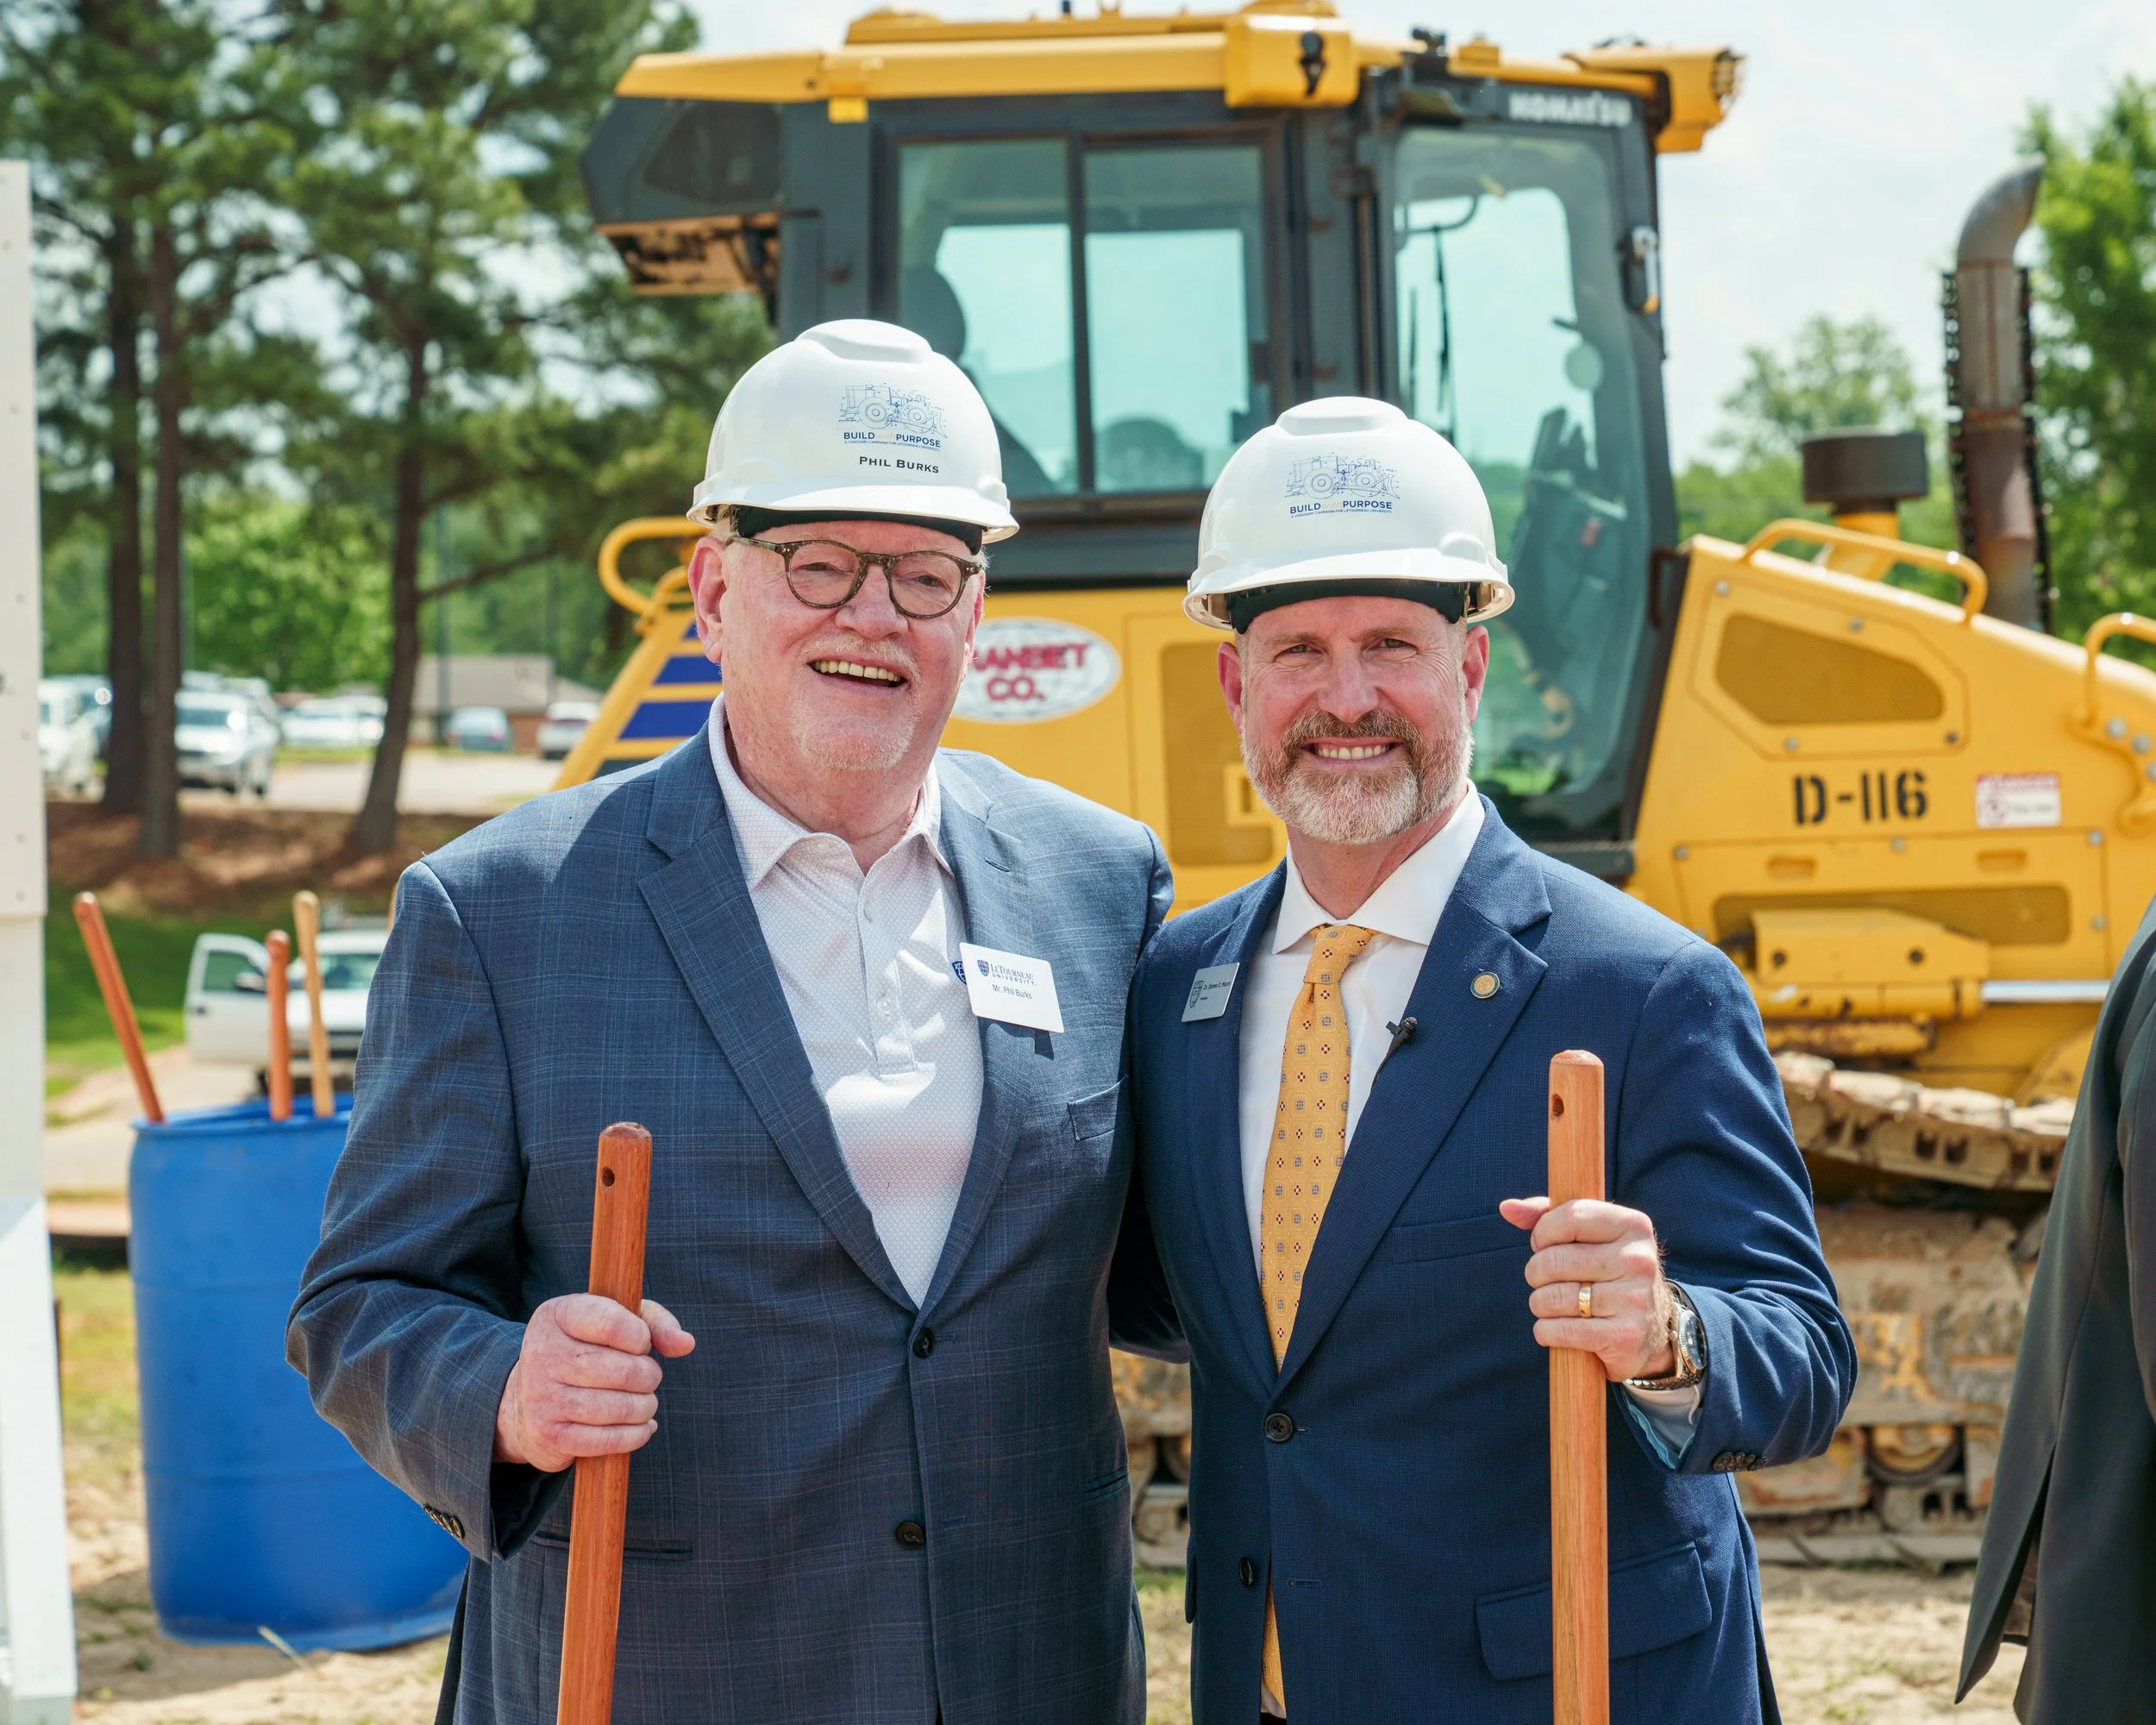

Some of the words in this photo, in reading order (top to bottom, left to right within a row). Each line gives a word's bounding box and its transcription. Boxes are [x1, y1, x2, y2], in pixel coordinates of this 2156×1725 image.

[1510, 91, 1633, 127] KOMATSU
[843, 431, 875, 440] BUILD
[896, 433, 941, 448] PURPOSE
[1290, 503, 1321, 514] BUILD
[1343, 500, 1393, 510] PURPOSE
[987, 675, 1046, 702] CO.
[1795, 768, 1928, 825] D-116
[992, 983, 1002, 993] Mr.
[1003, 986, 1015, 995] Phil
[1015, 988, 1032, 1000] Burks
